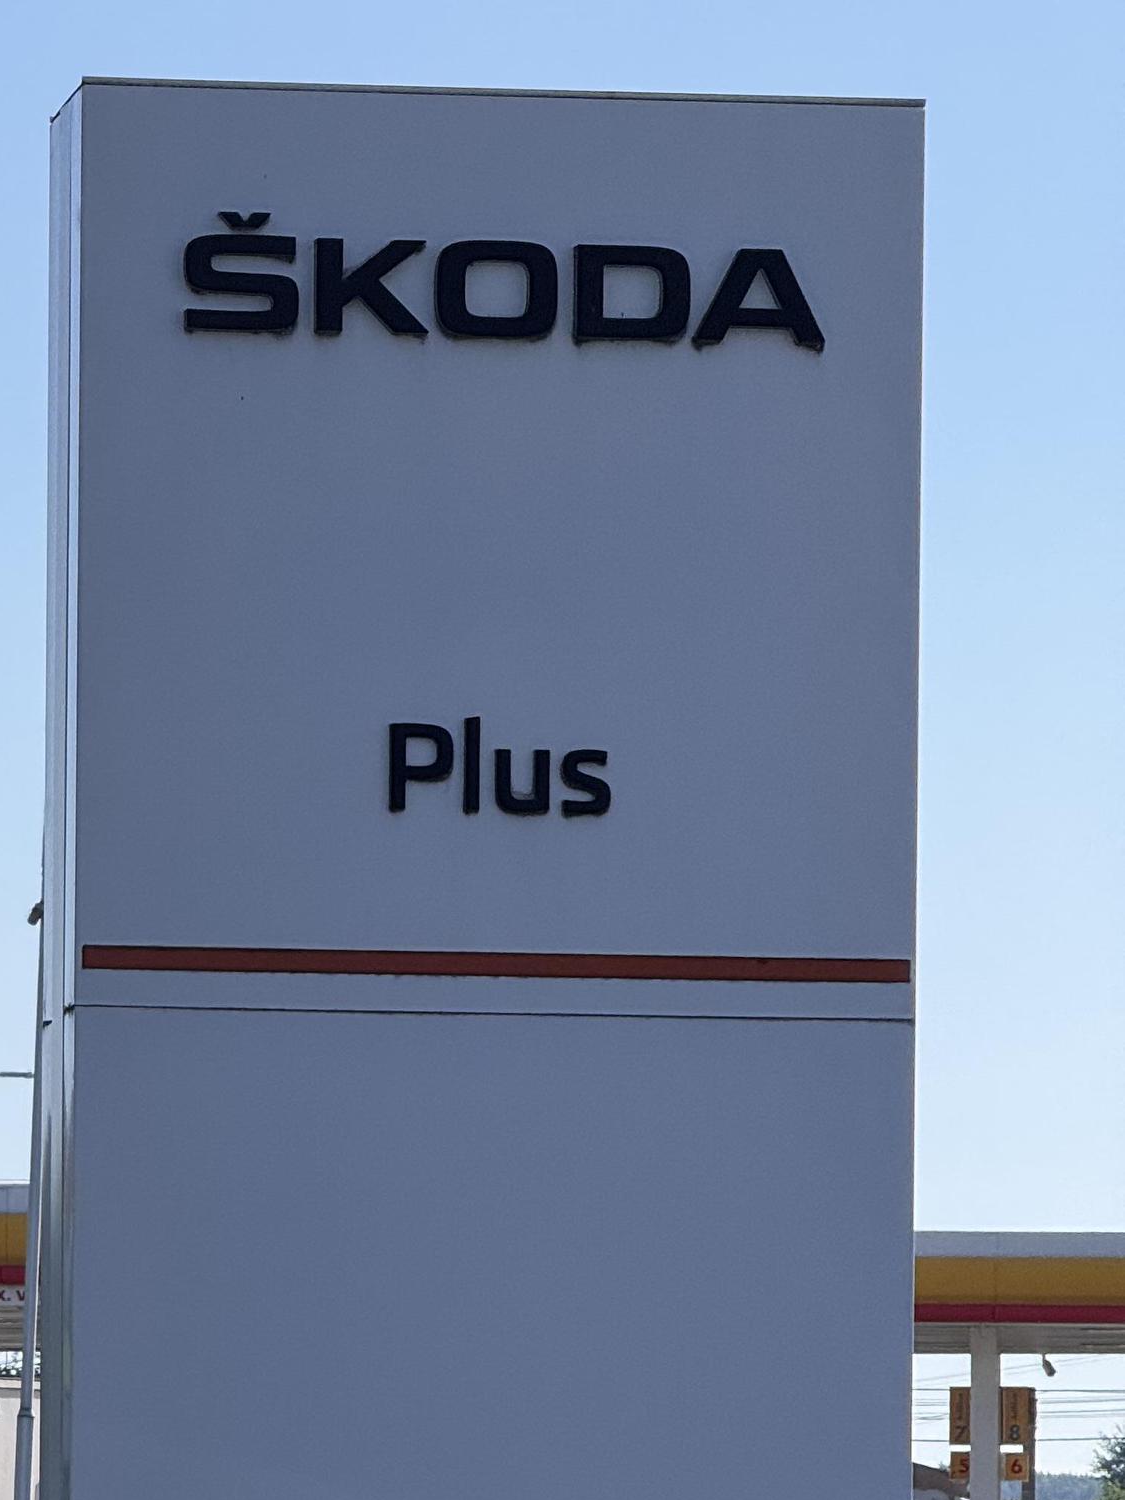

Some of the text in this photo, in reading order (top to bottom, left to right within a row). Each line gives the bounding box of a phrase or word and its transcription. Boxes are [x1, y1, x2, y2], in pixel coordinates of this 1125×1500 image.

[183, 211, 825, 352] ŠKODA
[387, 716, 612, 817] Plus
[1010, 1425, 1020, 1440] 8
[1011, 1459, 1022, 1473] 6
